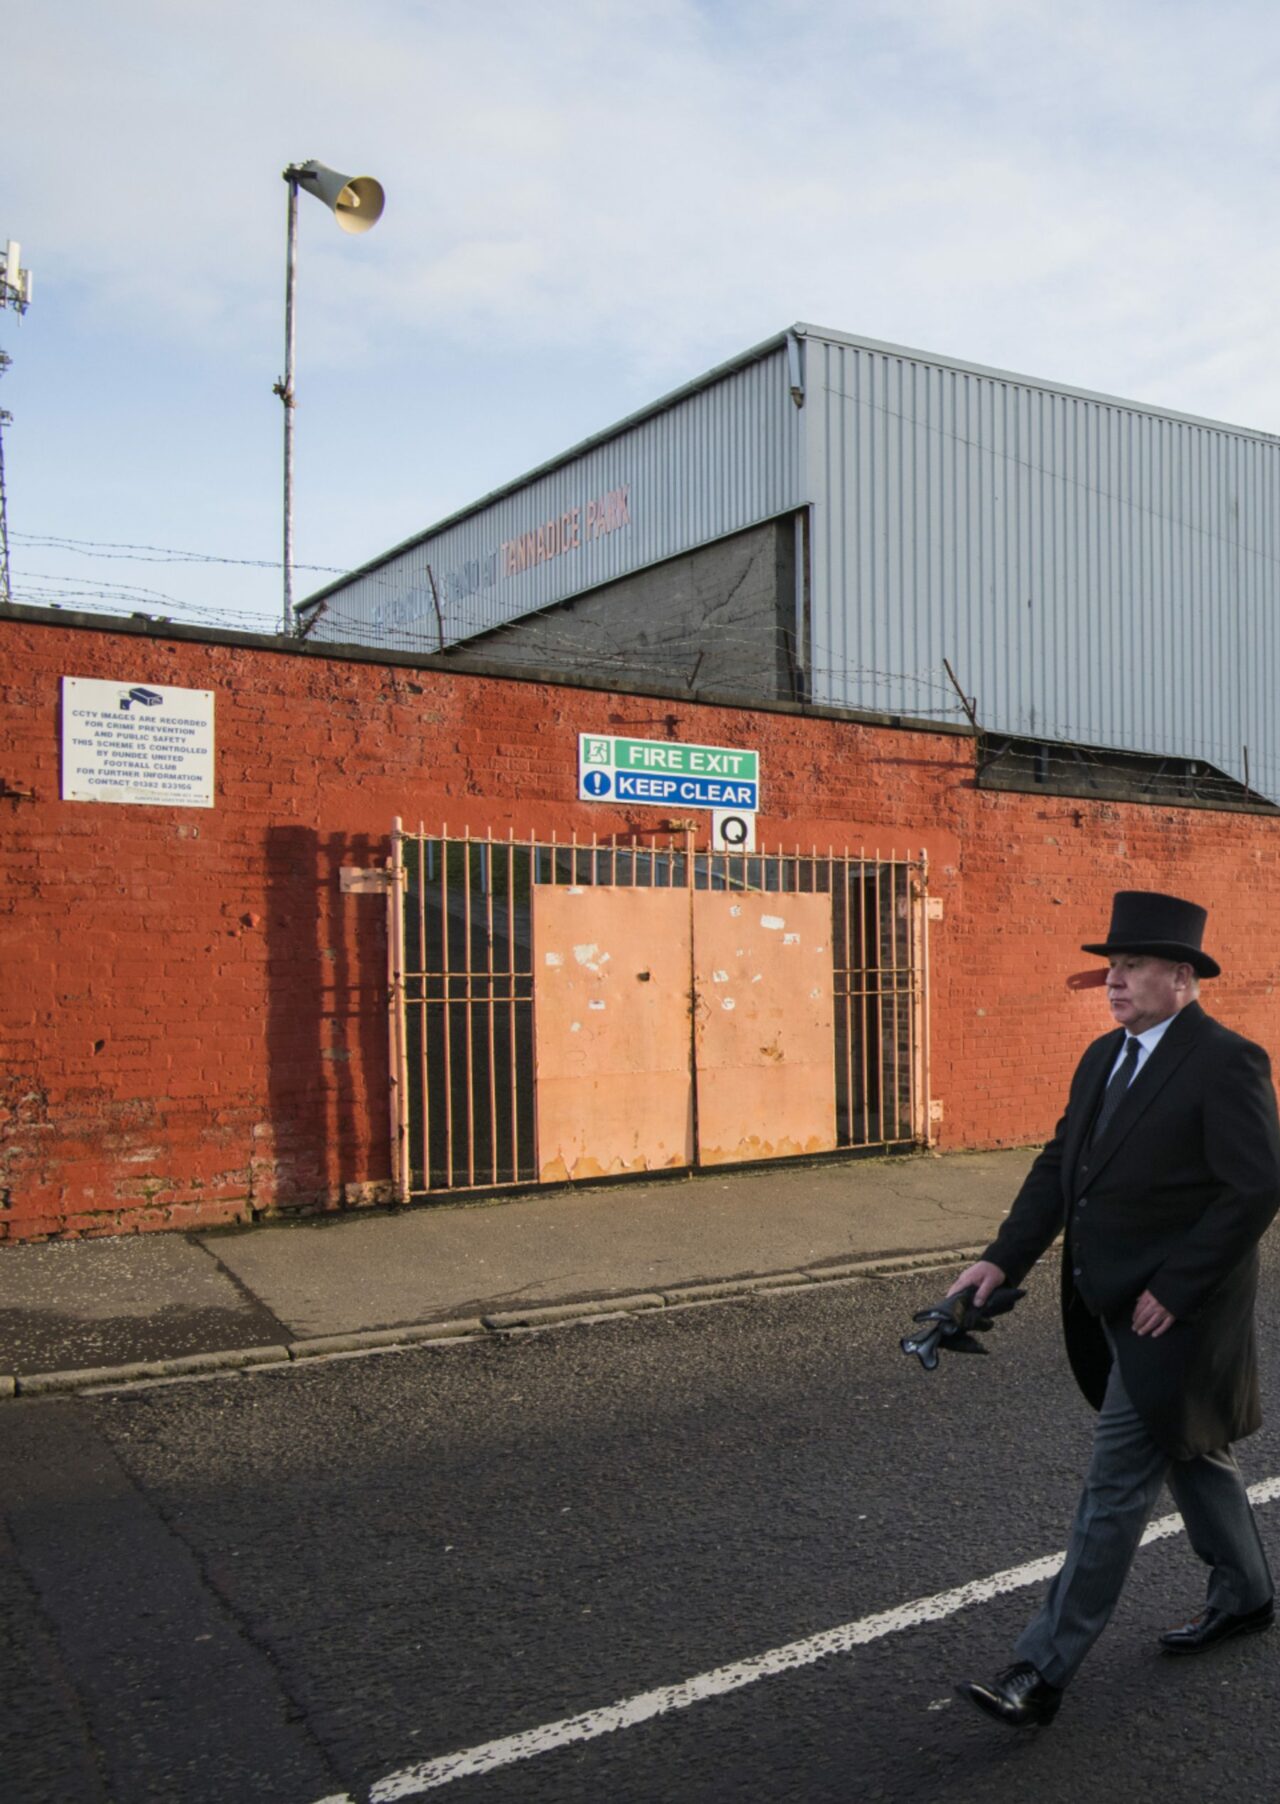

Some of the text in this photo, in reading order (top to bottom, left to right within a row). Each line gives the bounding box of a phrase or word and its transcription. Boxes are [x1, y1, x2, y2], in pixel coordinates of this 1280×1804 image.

[501, 484, 631, 579] TANNADICE PARK
[72, 710, 207, 727] CCTV IMAGES ARE RECORDED
[85, 720, 195, 735] FOR CRIME PREVENTION
[116, 732, 149, 741] PUBLIC
[153, 735, 186, 744] SAFETY
[72, 738, 93, 746] THIS
[97, 740, 134, 749] SCHEME
[150, 744, 207, 754] CONTROLLED
[112, 751, 148, 760] DUNDEE
[152, 754, 184, 762] UNITED
[628, 745, 743, 774] FIRE EXIT
[104, 760, 177, 771] FOOTBALL CLUB
[88, 778, 130, 786] CONTACT
[98, 769, 140, 778] FURTHER
[143, 772, 203, 781] INFORMATION
[619, 776, 752, 804] KEEP CLEAR
[720, 816, 748, 845] Q
